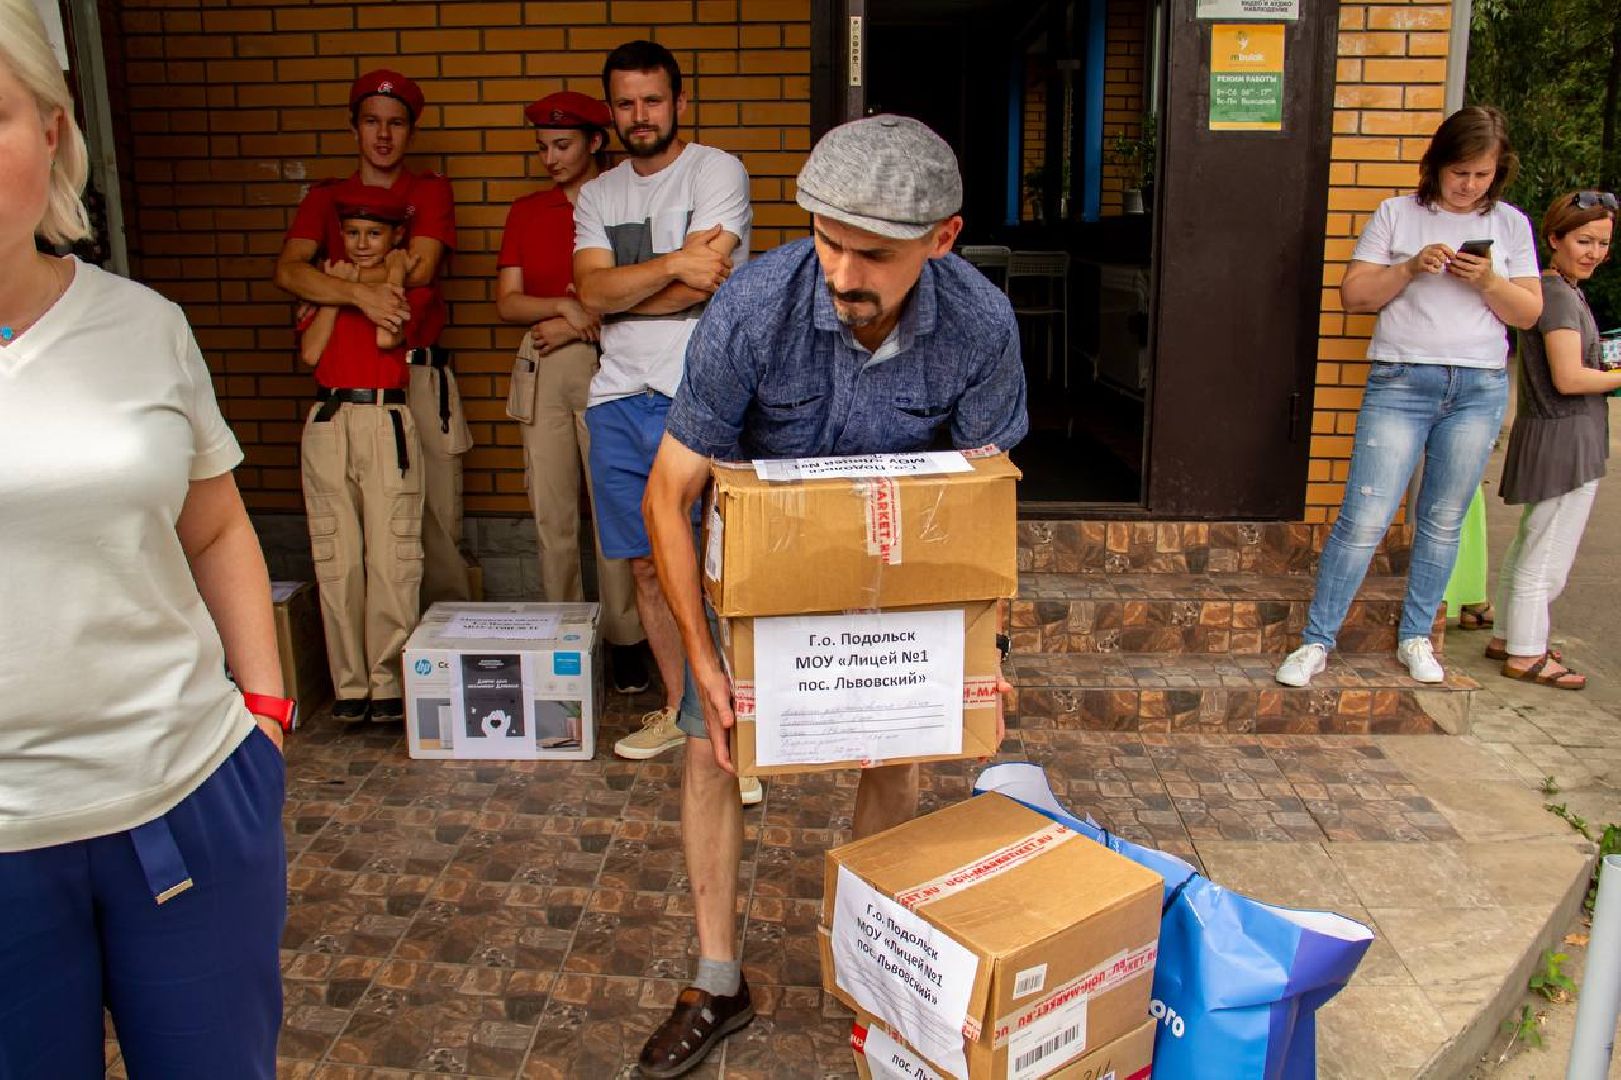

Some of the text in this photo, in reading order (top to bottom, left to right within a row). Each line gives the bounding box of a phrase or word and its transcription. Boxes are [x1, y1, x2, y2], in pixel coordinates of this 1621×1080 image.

[1216, 75, 1277, 83] РЕЖИМ РАБОТЫ
[809, 631, 916, 648] Г.о. Подольск
[795, 649, 929, 671] МОУ «Лицей №1
[798, 673, 926, 692] пос. Львовский»
[866, 903, 938, 961] Г.о. Подольск
[857, 917, 943, 988] МОУ «Лицей №1
[857, 939, 938, 1005] пос. Львовский»
[891, 1053, 912, 1075] пос.
